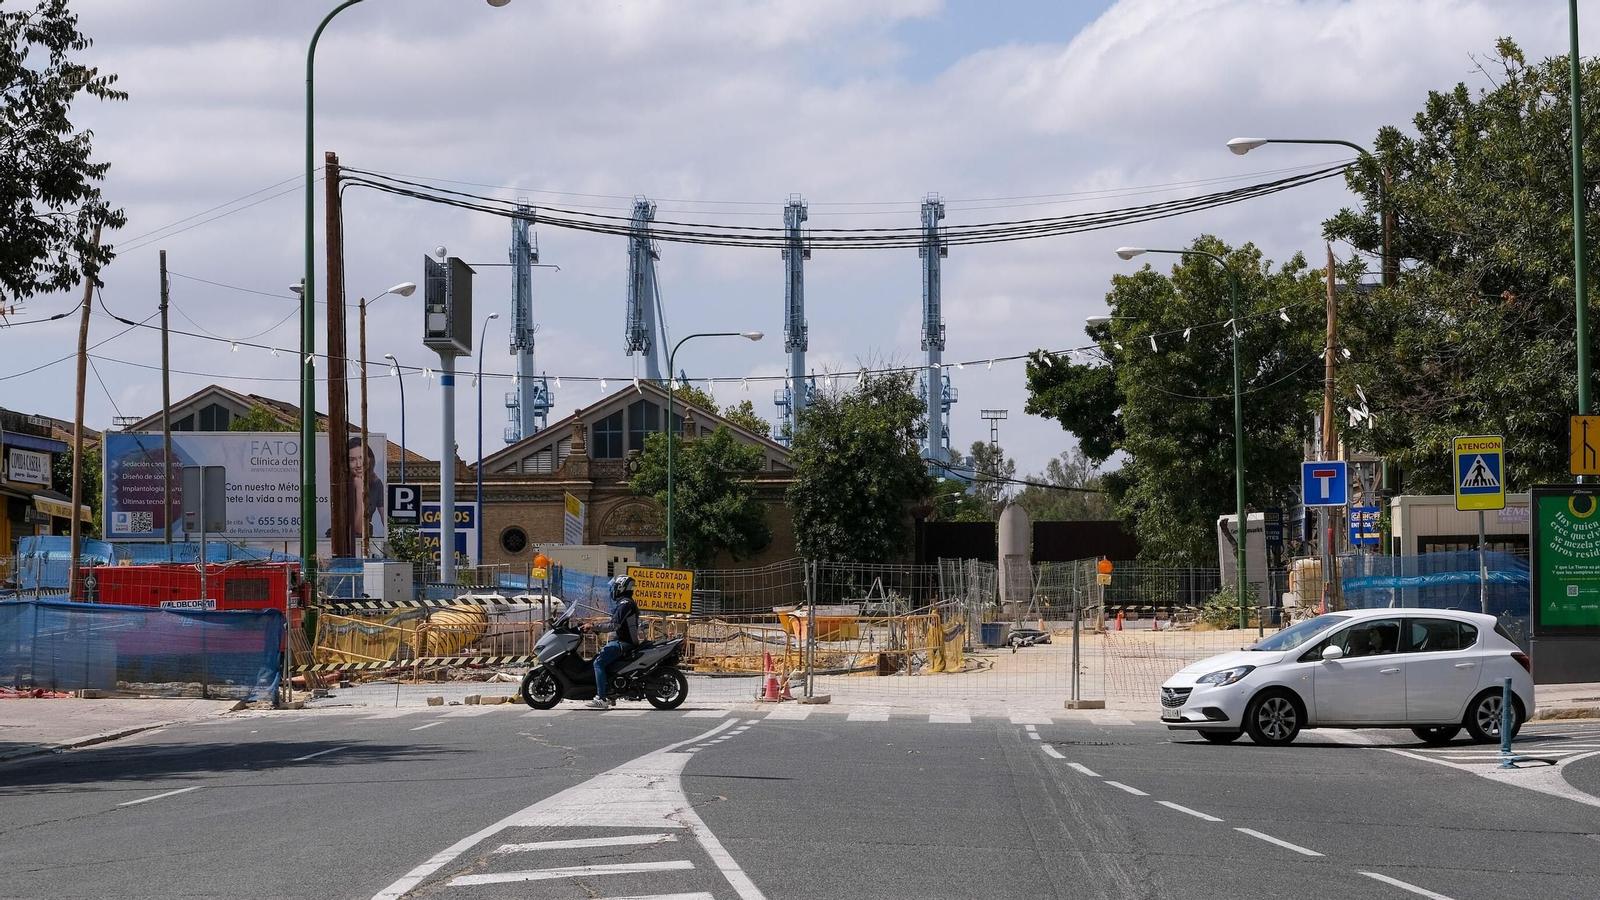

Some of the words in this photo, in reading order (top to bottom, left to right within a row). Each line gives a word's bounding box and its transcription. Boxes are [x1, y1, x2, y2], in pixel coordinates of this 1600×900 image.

[251, 441, 298, 456] FATO
[1457, 441, 1501, 450] ATENCIÓN
[11, 452, 26, 470] COMIDA
[250, 457, 280, 466] Clínica
[122, 485, 165, 493] Implantología
[225, 482, 242, 491] Con
[244, 483, 276, 491] nuestro
[278, 482, 300, 491] Méto
[246, 494, 254, 503] la
[256, 494, 275, 503] vida
[258, 516, 275, 525] 655
[277, 516, 288, 525] 56
[1555, 511, 1572, 527] Hay
[1572, 521, 1599, 531] quien
[1550, 521, 1569, 536] cree
[1570, 532, 1586, 541] que
[1587, 531, 1595, 540] el
[1553, 535, 1564, 544] se
[1563, 539, 1594, 549] mezcla
[1549, 542, 1574, 557] otros
[1575, 547, 1600, 559] resid
[633, 570, 654, 579] CALLE
[655, 571, 688, 581] CORTADA
[676, 582, 690, 591] POR
[635, 589, 662, 599] CHAVES
[663, 591, 677, 600] REY
[678, 592, 683, 600] Y
[651, 600, 687, 610] PALMERAS
